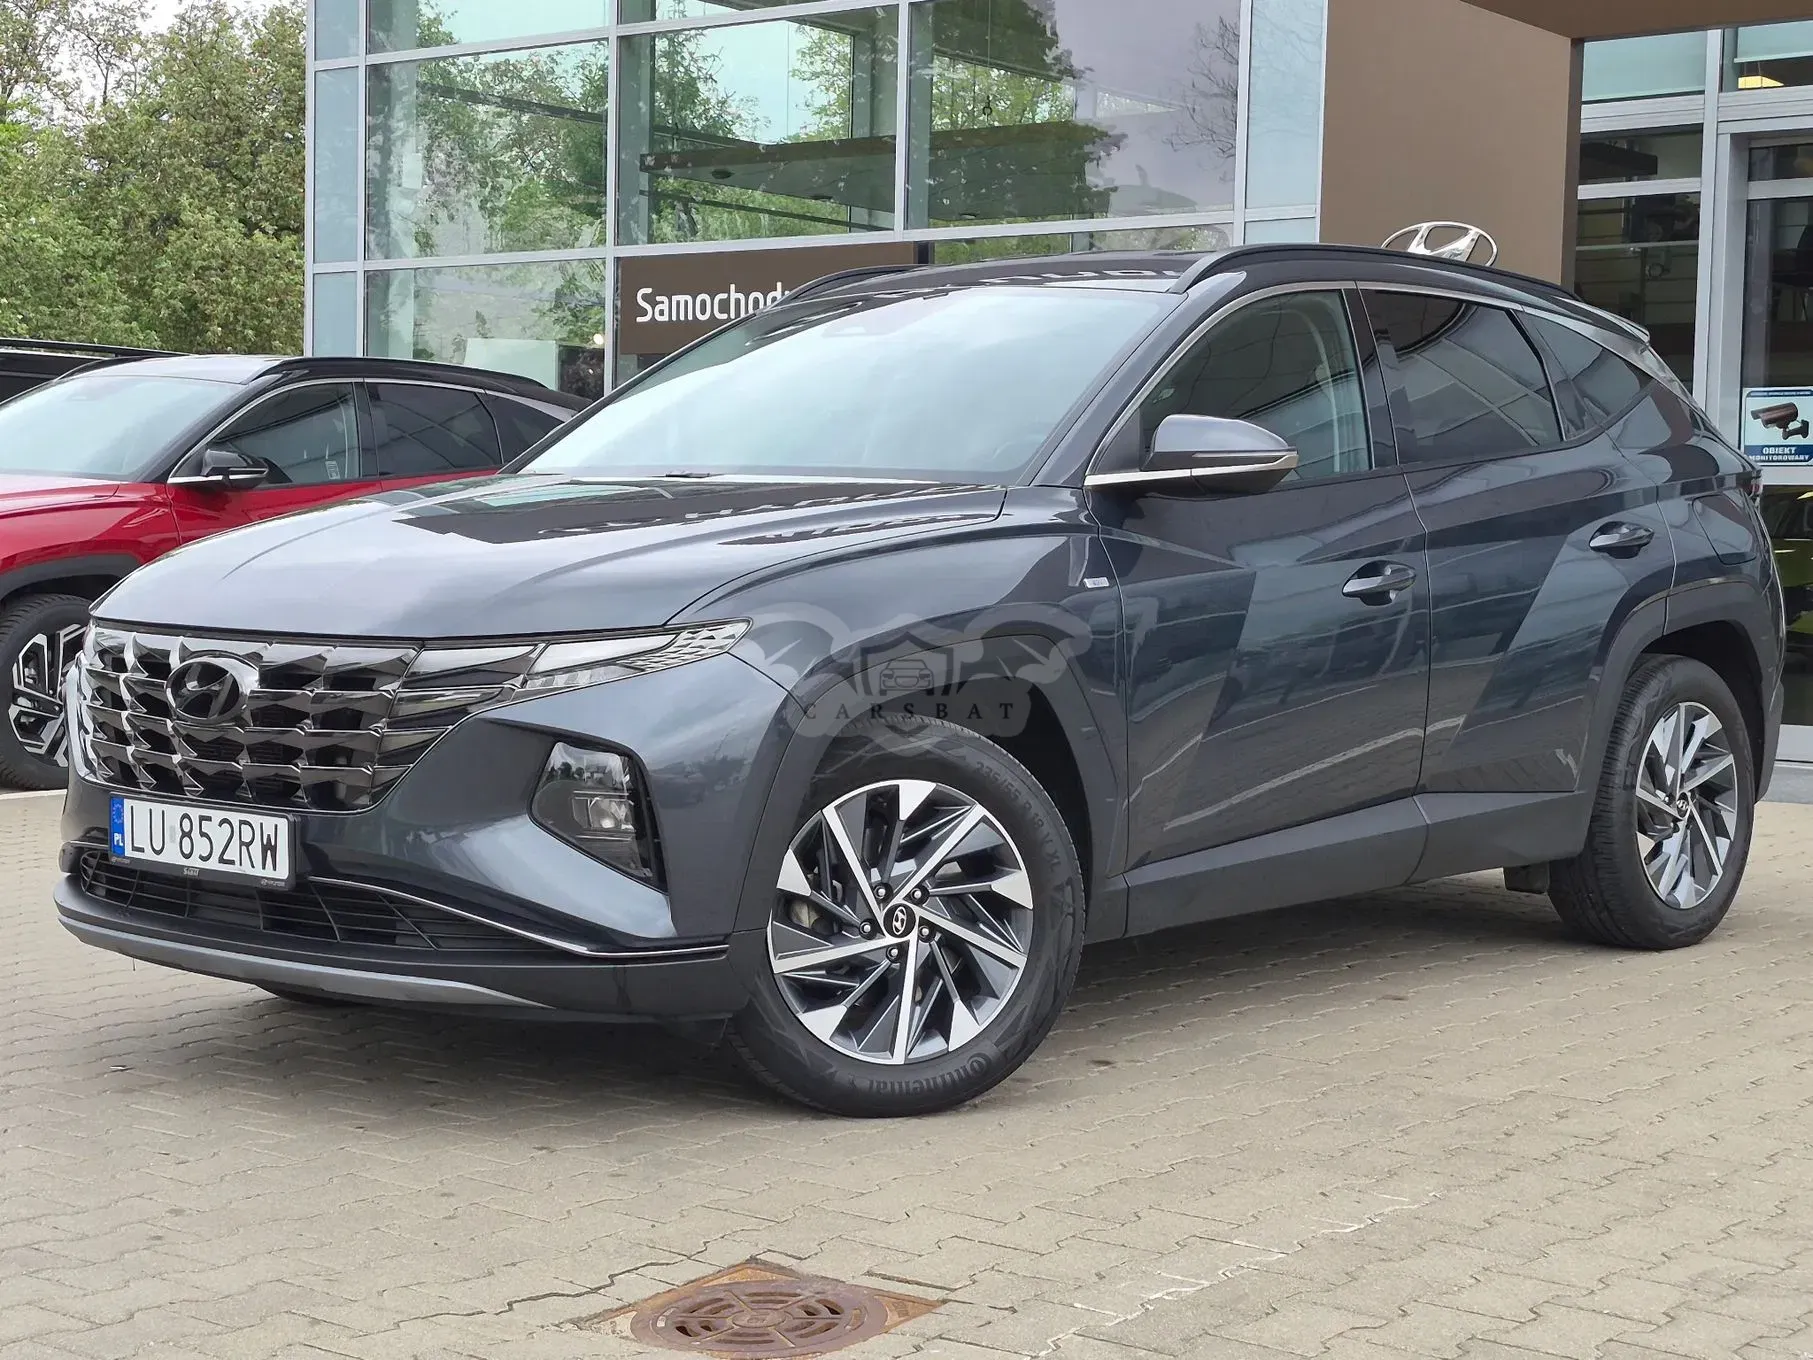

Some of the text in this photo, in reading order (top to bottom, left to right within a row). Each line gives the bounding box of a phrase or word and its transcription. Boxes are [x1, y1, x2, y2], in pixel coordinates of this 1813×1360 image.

[636, 281, 790, 323] Samochod
[1762, 447, 1796, 455] OBIEKT
[113, 832, 124, 847] PL
[130, 805, 278, 871] LU 852RW
